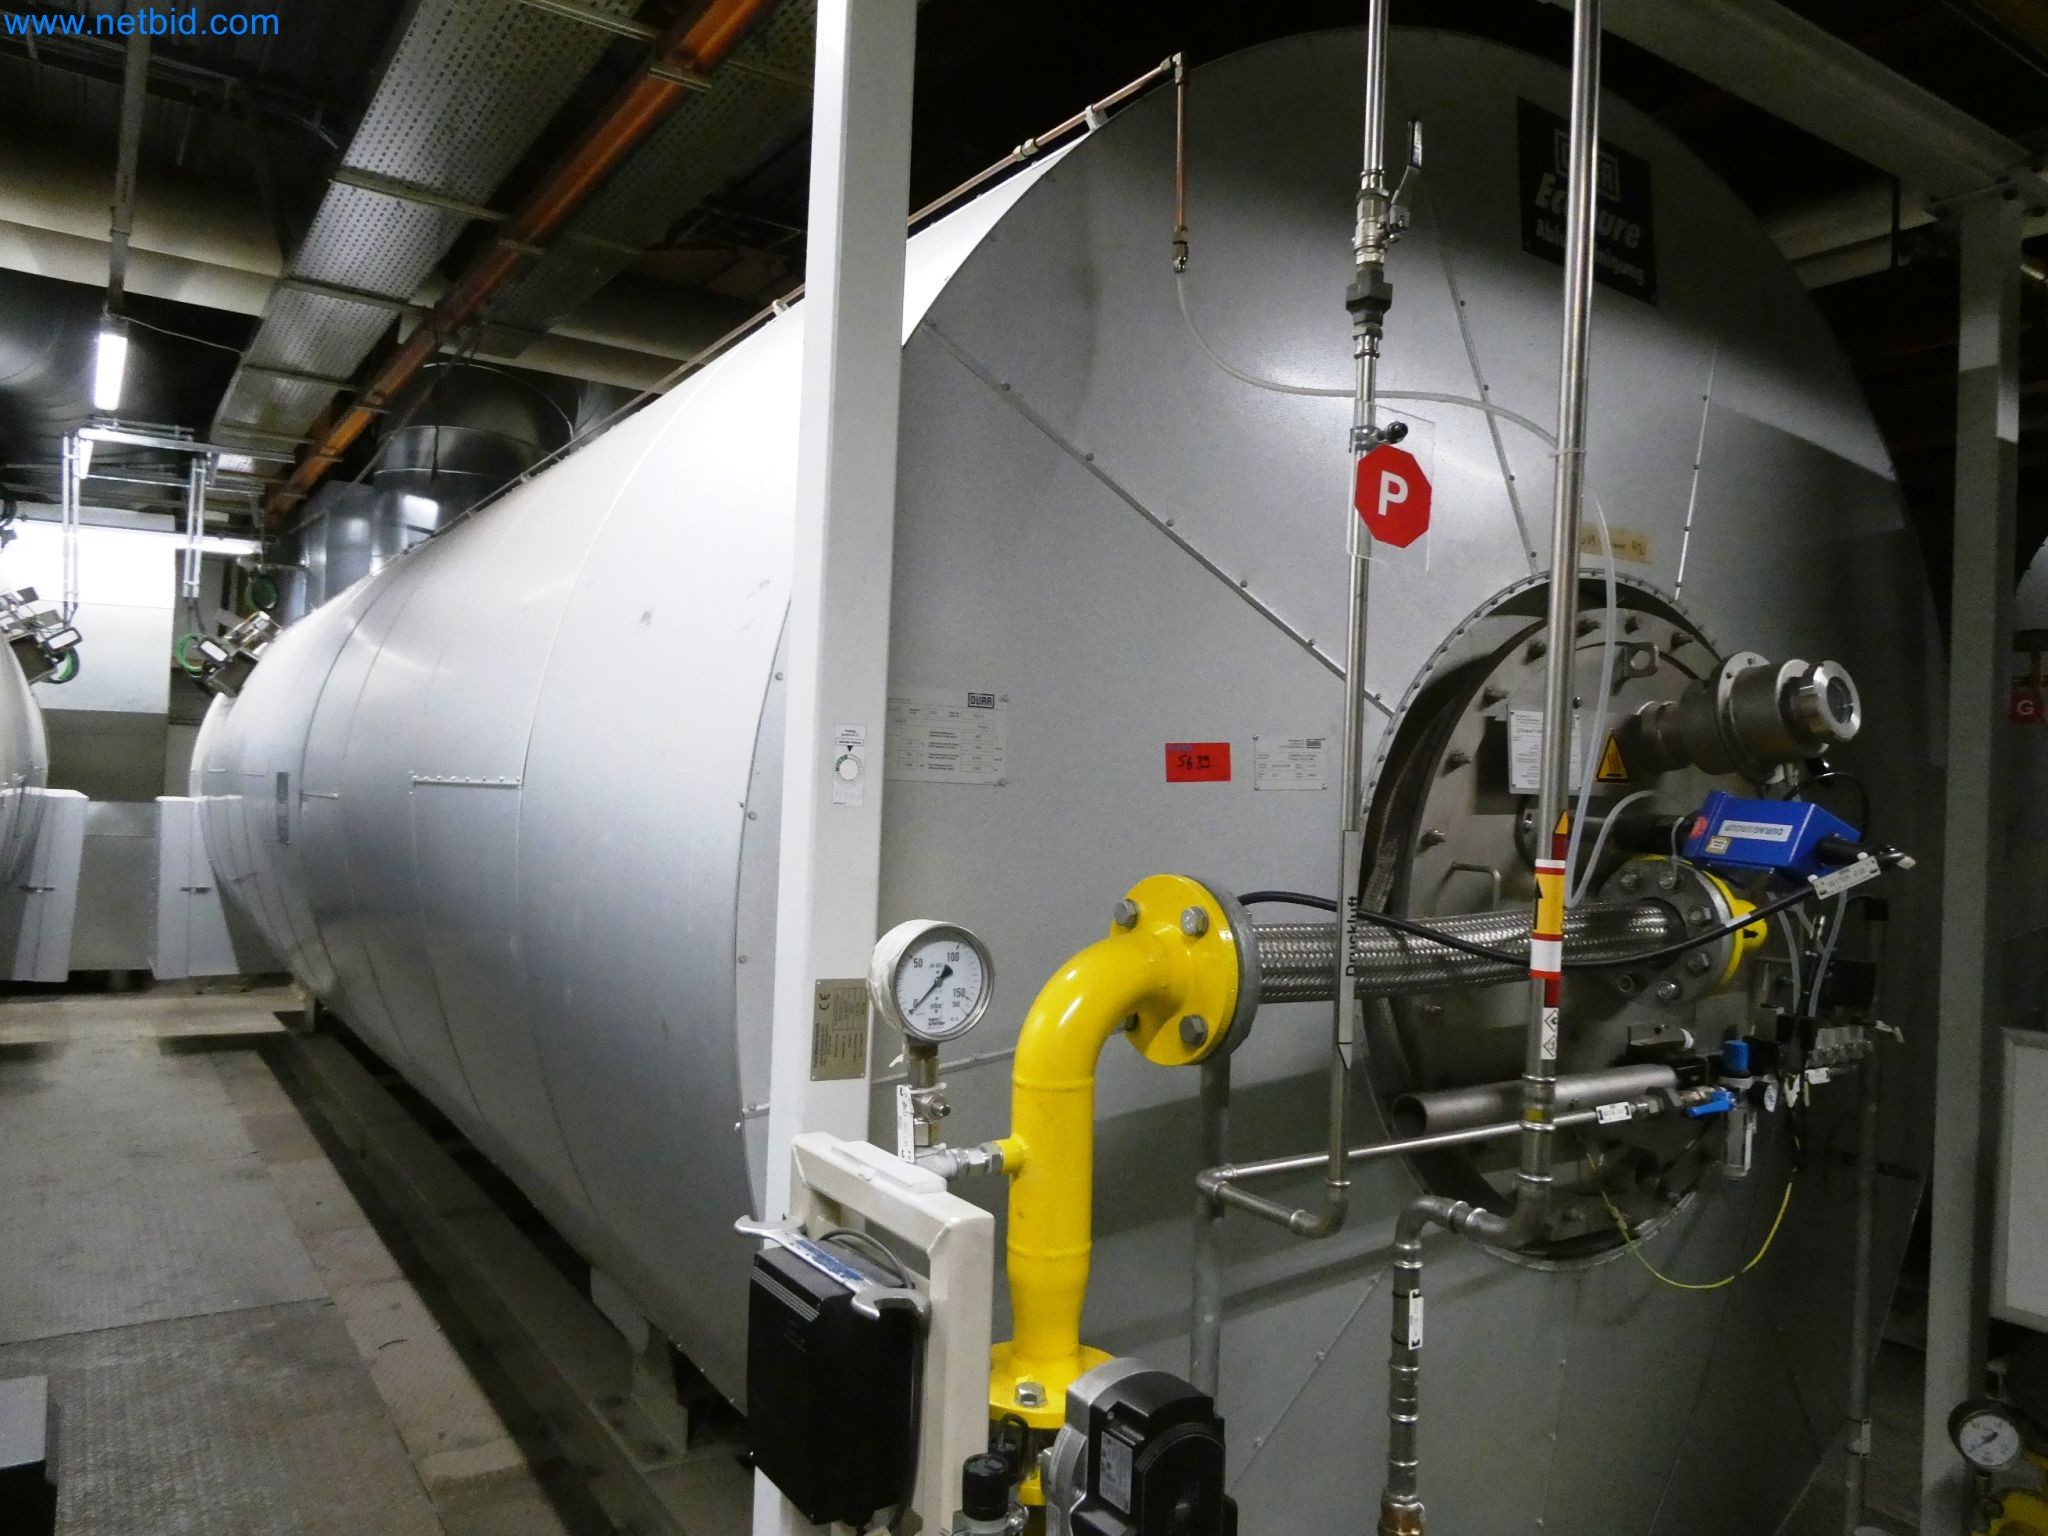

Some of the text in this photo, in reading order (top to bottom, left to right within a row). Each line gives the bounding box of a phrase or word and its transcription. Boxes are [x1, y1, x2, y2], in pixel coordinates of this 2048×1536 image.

[1378, 470, 1409, 516] P
[2017, 700, 2034, 715] G
[947, 952, 960, 962] 100
[913, 958, 923, 968] 50
[953, 987, 966, 997] 150
